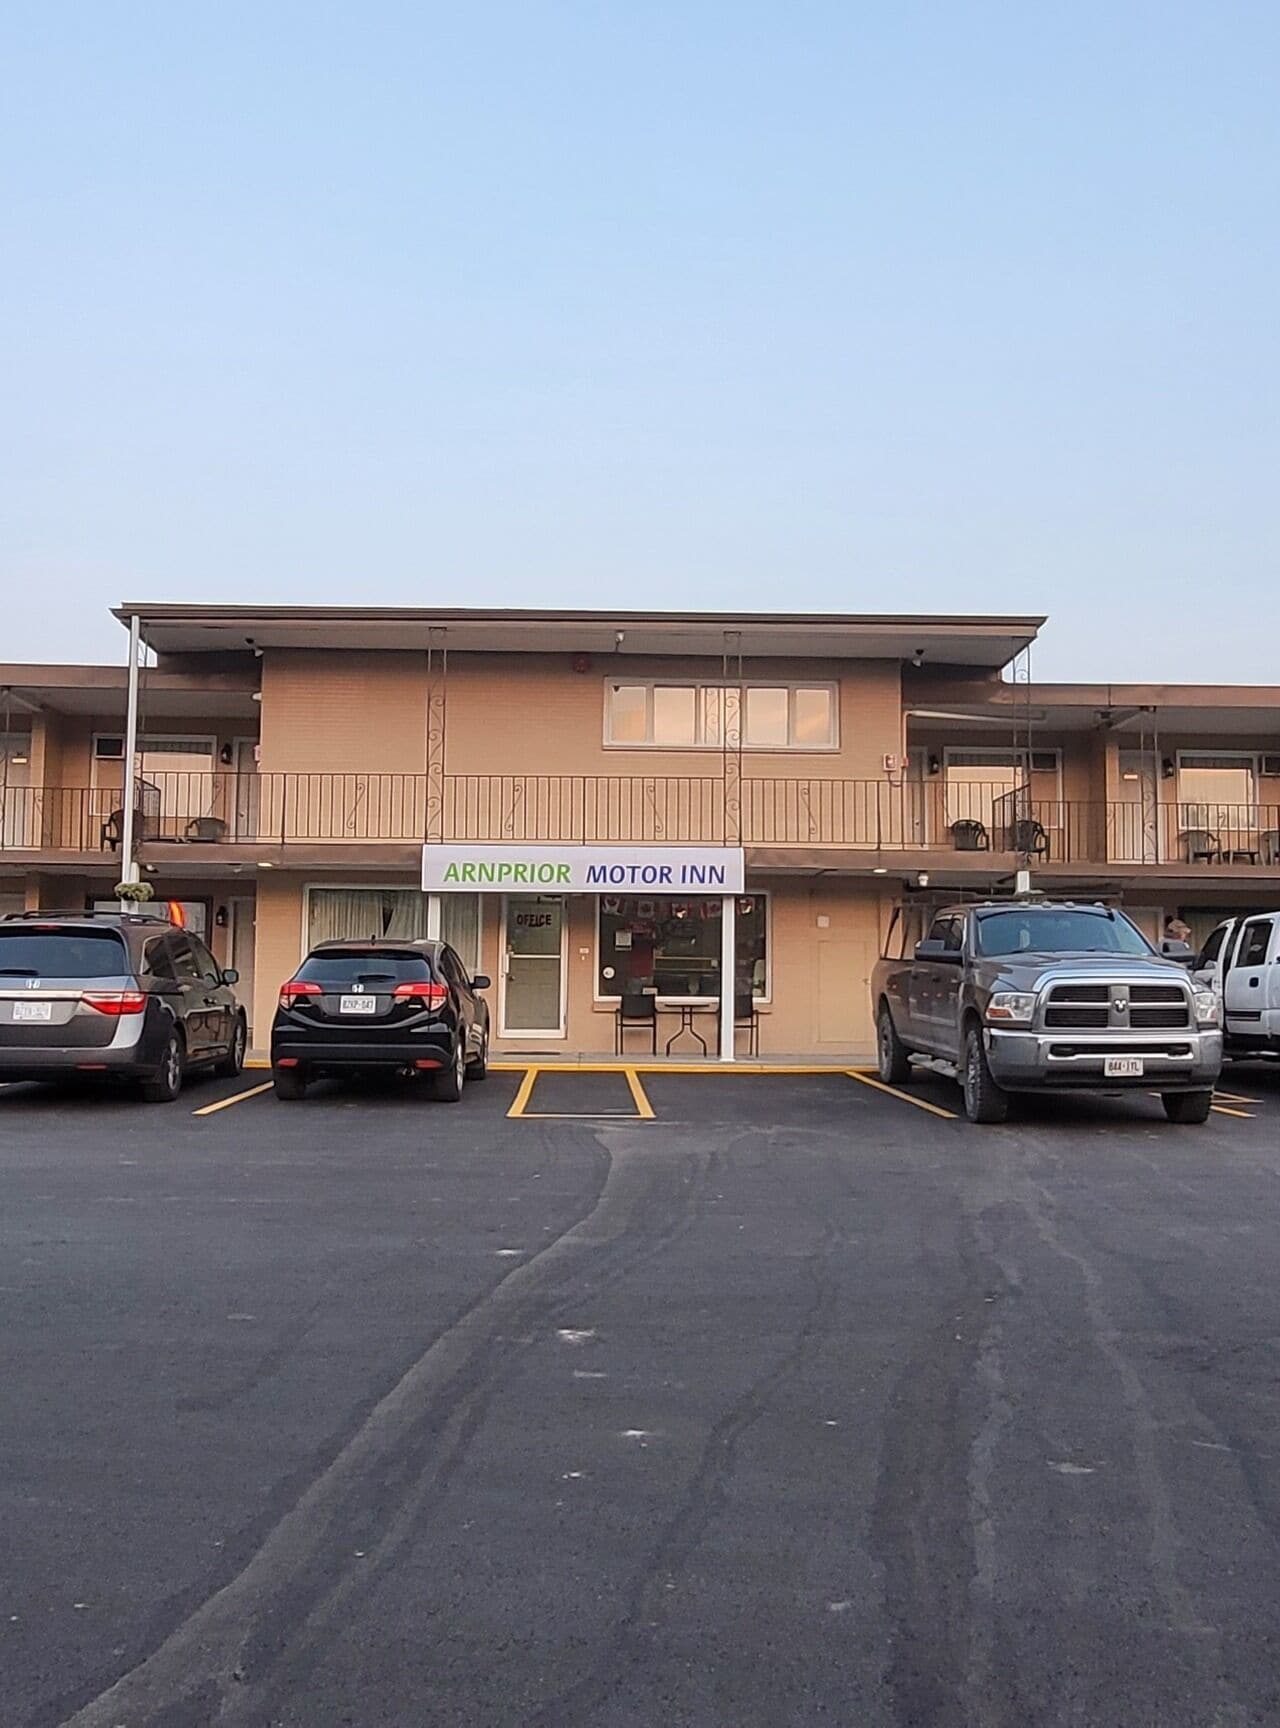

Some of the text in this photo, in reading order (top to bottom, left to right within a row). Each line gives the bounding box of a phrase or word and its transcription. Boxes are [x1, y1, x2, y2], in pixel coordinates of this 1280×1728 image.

[443, 862, 726, 885] ARNPRIOR MOTOR INN
[516, 914, 552, 927] OFFICE
